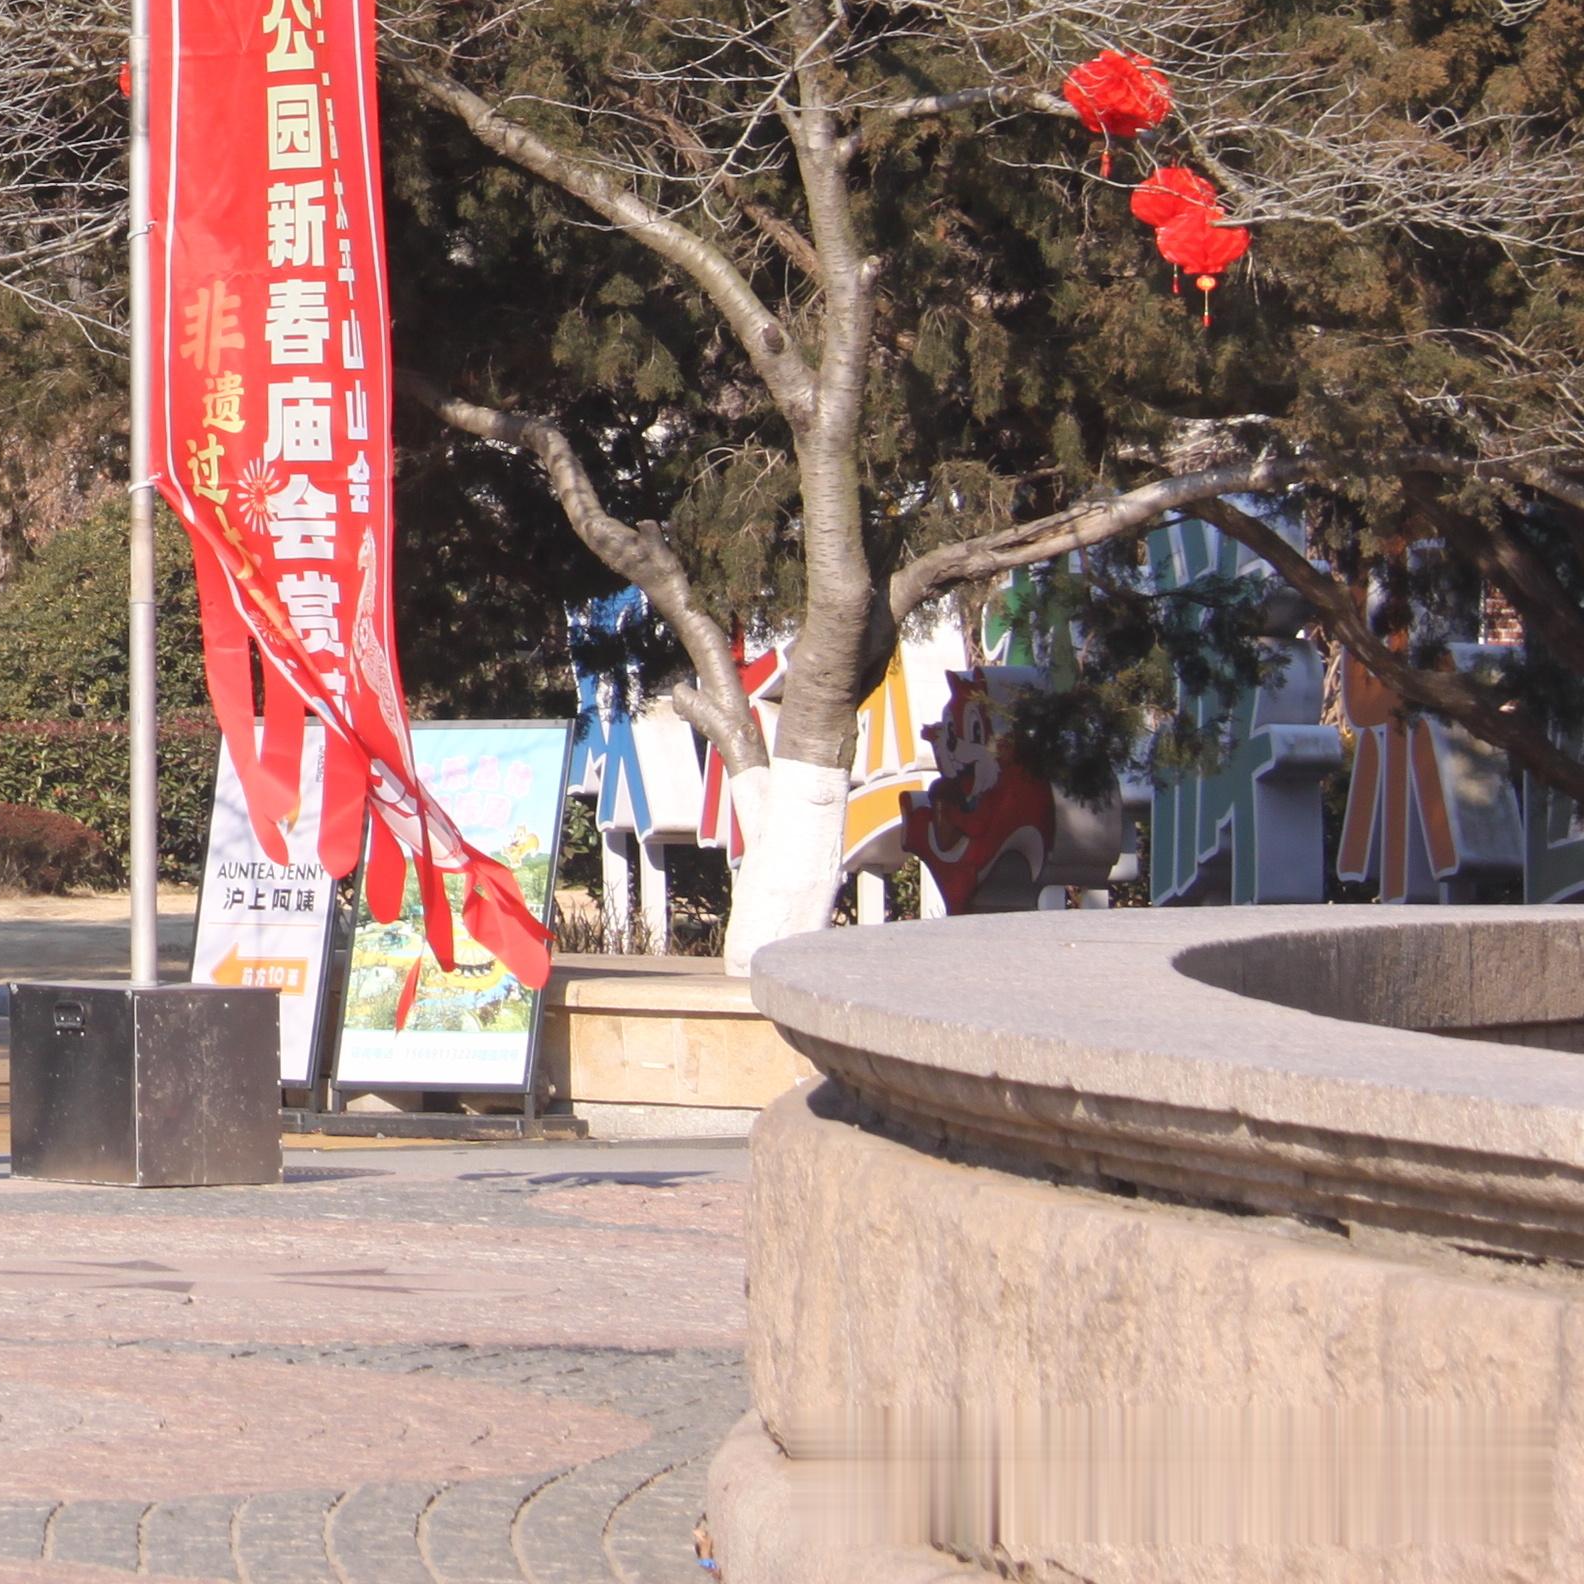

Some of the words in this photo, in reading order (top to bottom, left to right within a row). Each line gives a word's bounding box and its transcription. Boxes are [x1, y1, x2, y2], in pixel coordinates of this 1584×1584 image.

[217, 862, 276, 880] AUNTEA
[280, 862, 325, 880] JENNY
[222, 887, 315, 912] 沪上阿姨
